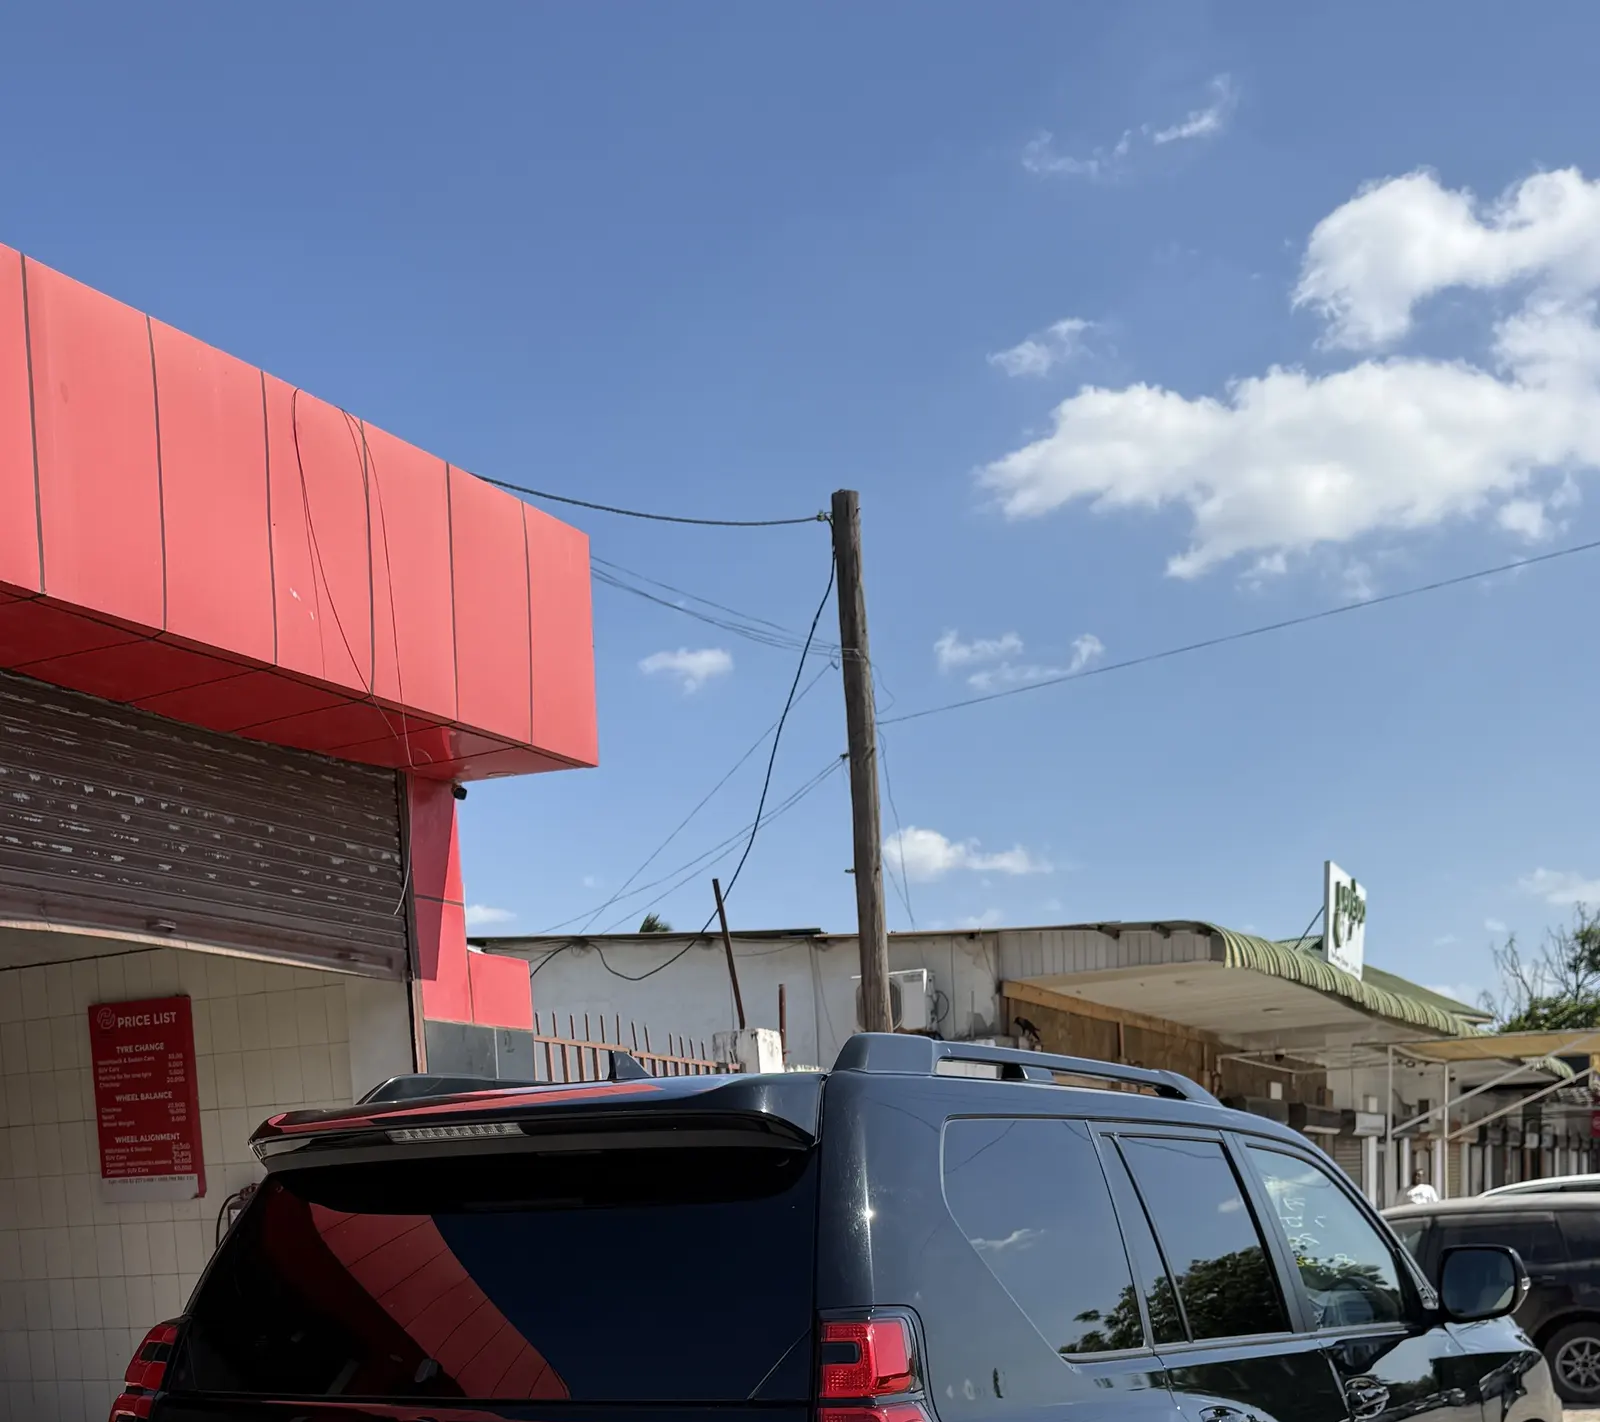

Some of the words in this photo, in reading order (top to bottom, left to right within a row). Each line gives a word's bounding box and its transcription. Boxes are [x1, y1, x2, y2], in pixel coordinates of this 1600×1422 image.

[117, 1014, 150, 1028] PRICE
[153, 1011, 177, 1025] LIST
[116, 1045, 134, 1054] TYRE
[134, 1042, 164, 1052] CHANGE
[115, 1093, 140, 1102] WHEEL
[140, 1091, 173, 1101] BALANCE
[115, 1135, 139, 1143] WHEEL
[140, 1132, 180, 1142] ALIGNMENT
